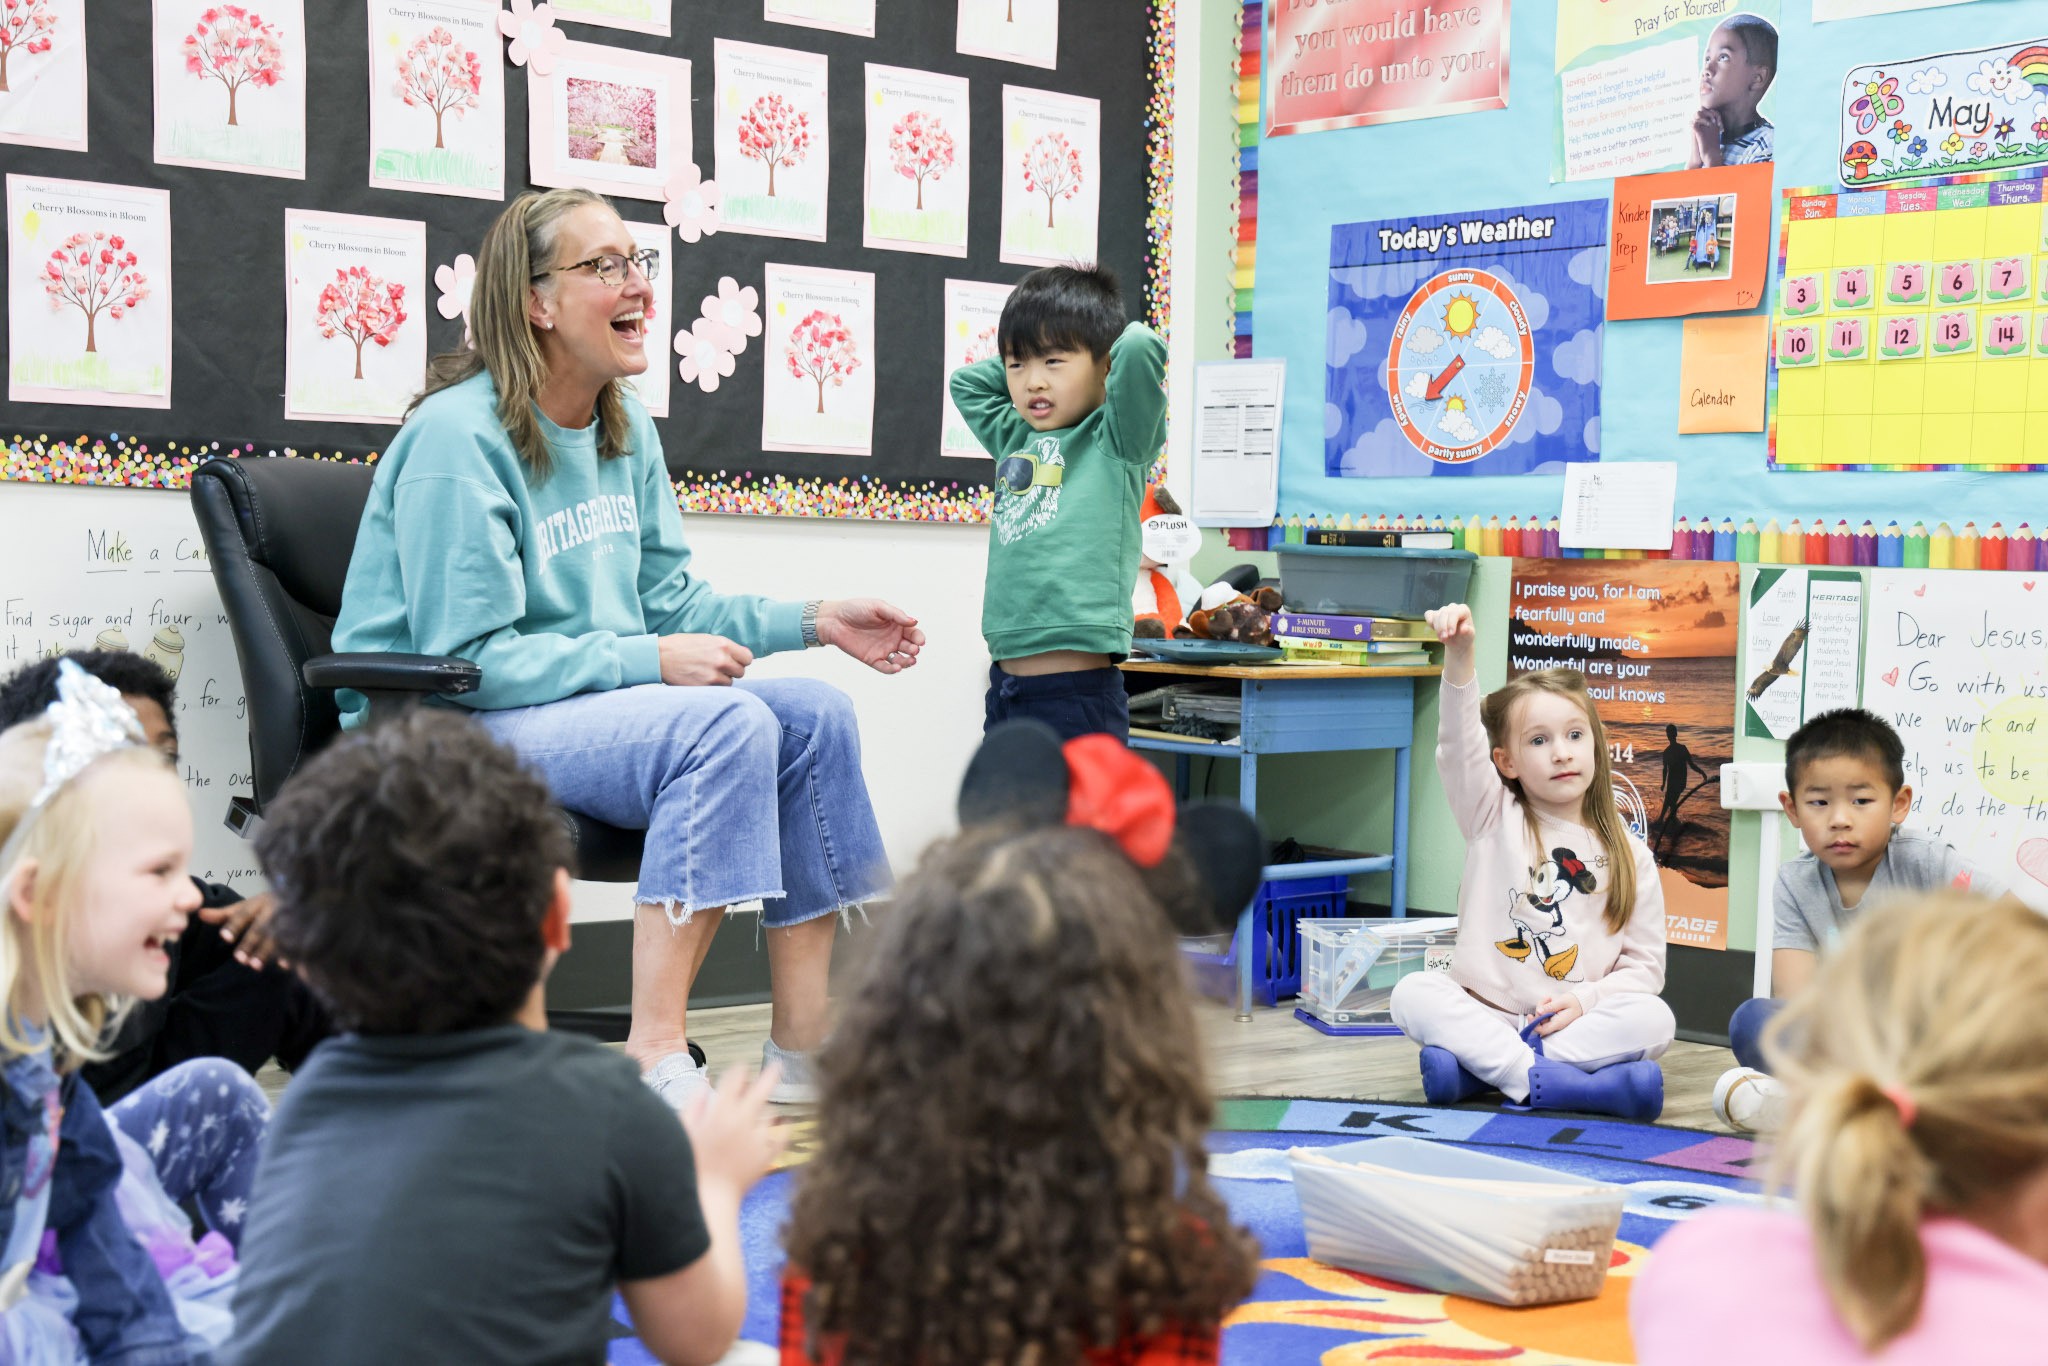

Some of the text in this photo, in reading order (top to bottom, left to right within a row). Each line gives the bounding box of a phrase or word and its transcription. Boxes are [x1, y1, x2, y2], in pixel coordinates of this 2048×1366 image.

[388, 7, 484, 28] Cherry Blossoms in Bloom
[1634, 0, 1726, 35] Pray for Yourself
[1294, 6, 1482, 59] you would have
[1281, 50, 1496, 97] them do unto you.
[1928, 96, 1990, 134] May
[1608, 141, 1628, 151] better
[1801, 182, 2035, 208] Sunday Monday Tuesday Wednesday Thursday
[1804, 193, 2031, 219] Sun. Mon. Tues. Wed. Thurs.
[32, 202, 147, 222] Cherry Blossoms in Bloom
[1618, 201, 1651, 224] Kinder
[1378, 216, 1555, 253] Today's Weather
[308, 240, 407, 257] Cherry Blossoms in Bloom
[1616, 233, 1638, 263] Prep
[1447, 272, 1474, 284] sunny
[1797, 271, 2012, 303] 3 4 5 6 7
[1396, 311, 1411, 340] rainy
[1508, 300, 1529, 337] cloudy
[1791, 324, 2014, 353] 10 11 12 13 14
[1392, 393, 1409, 427] windy
[1504, 390, 1527, 428] snowy
[1691, 389, 1736, 408] Calendar
[1427, 444, 1483, 461] partly sunny
[1160, 521, 1188, 530] PLUSH
[88, 528, 134, 563] Make
[150, 548, 160, 560] a
[1515, 581, 1661, 601] I praise you, for I am
[1777, 587, 1796, 599] Faith
[1812, 594, 1859, 602] HERITAGE
[6, 598, 33, 628] Find
[49, 614, 94, 638] sugar
[105, 607, 133, 627] and
[148, 598, 202, 631] flour,
[1296, 617, 1326, 627] 5-MINUTE
[1515, 605, 1605, 625] fearfully and
[1762, 611, 1780, 623] Love
[1291, 626, 1331, 635] BIBLE STORIES
[1897, 609, 2048, 649] Dear Jesus,
[6, 634, 64, 660] it tak
[1513, 632, 1596, 652] wonderfully
[1752, 635, 1772, 648] Unity
[1512, 655, 1651, 679] Wonderful are your
[1908, 660, 2048, 699] Go with us
[200, 678, 220, 708] for
[1587, 686, 1665, 703] soul knows
[1768, 687, 1801, 701] Integrity
[1761, 710, 1796, 724] Diligence
[1895, 712, 2037, 735] We Work and
[184, 765, 211, 788] the
[1901, 750, 2031, 788] elp us to be
[1941, 792, 1964, 816] do
[1976, 796, 2006, 817] the
[204, 870, 214, 879] a
[1664, 915, 1719, 934] TAGE
[1670, 931, 1711, 944] ACADEMY
[1339, 1111, 1623, 1150] K L
